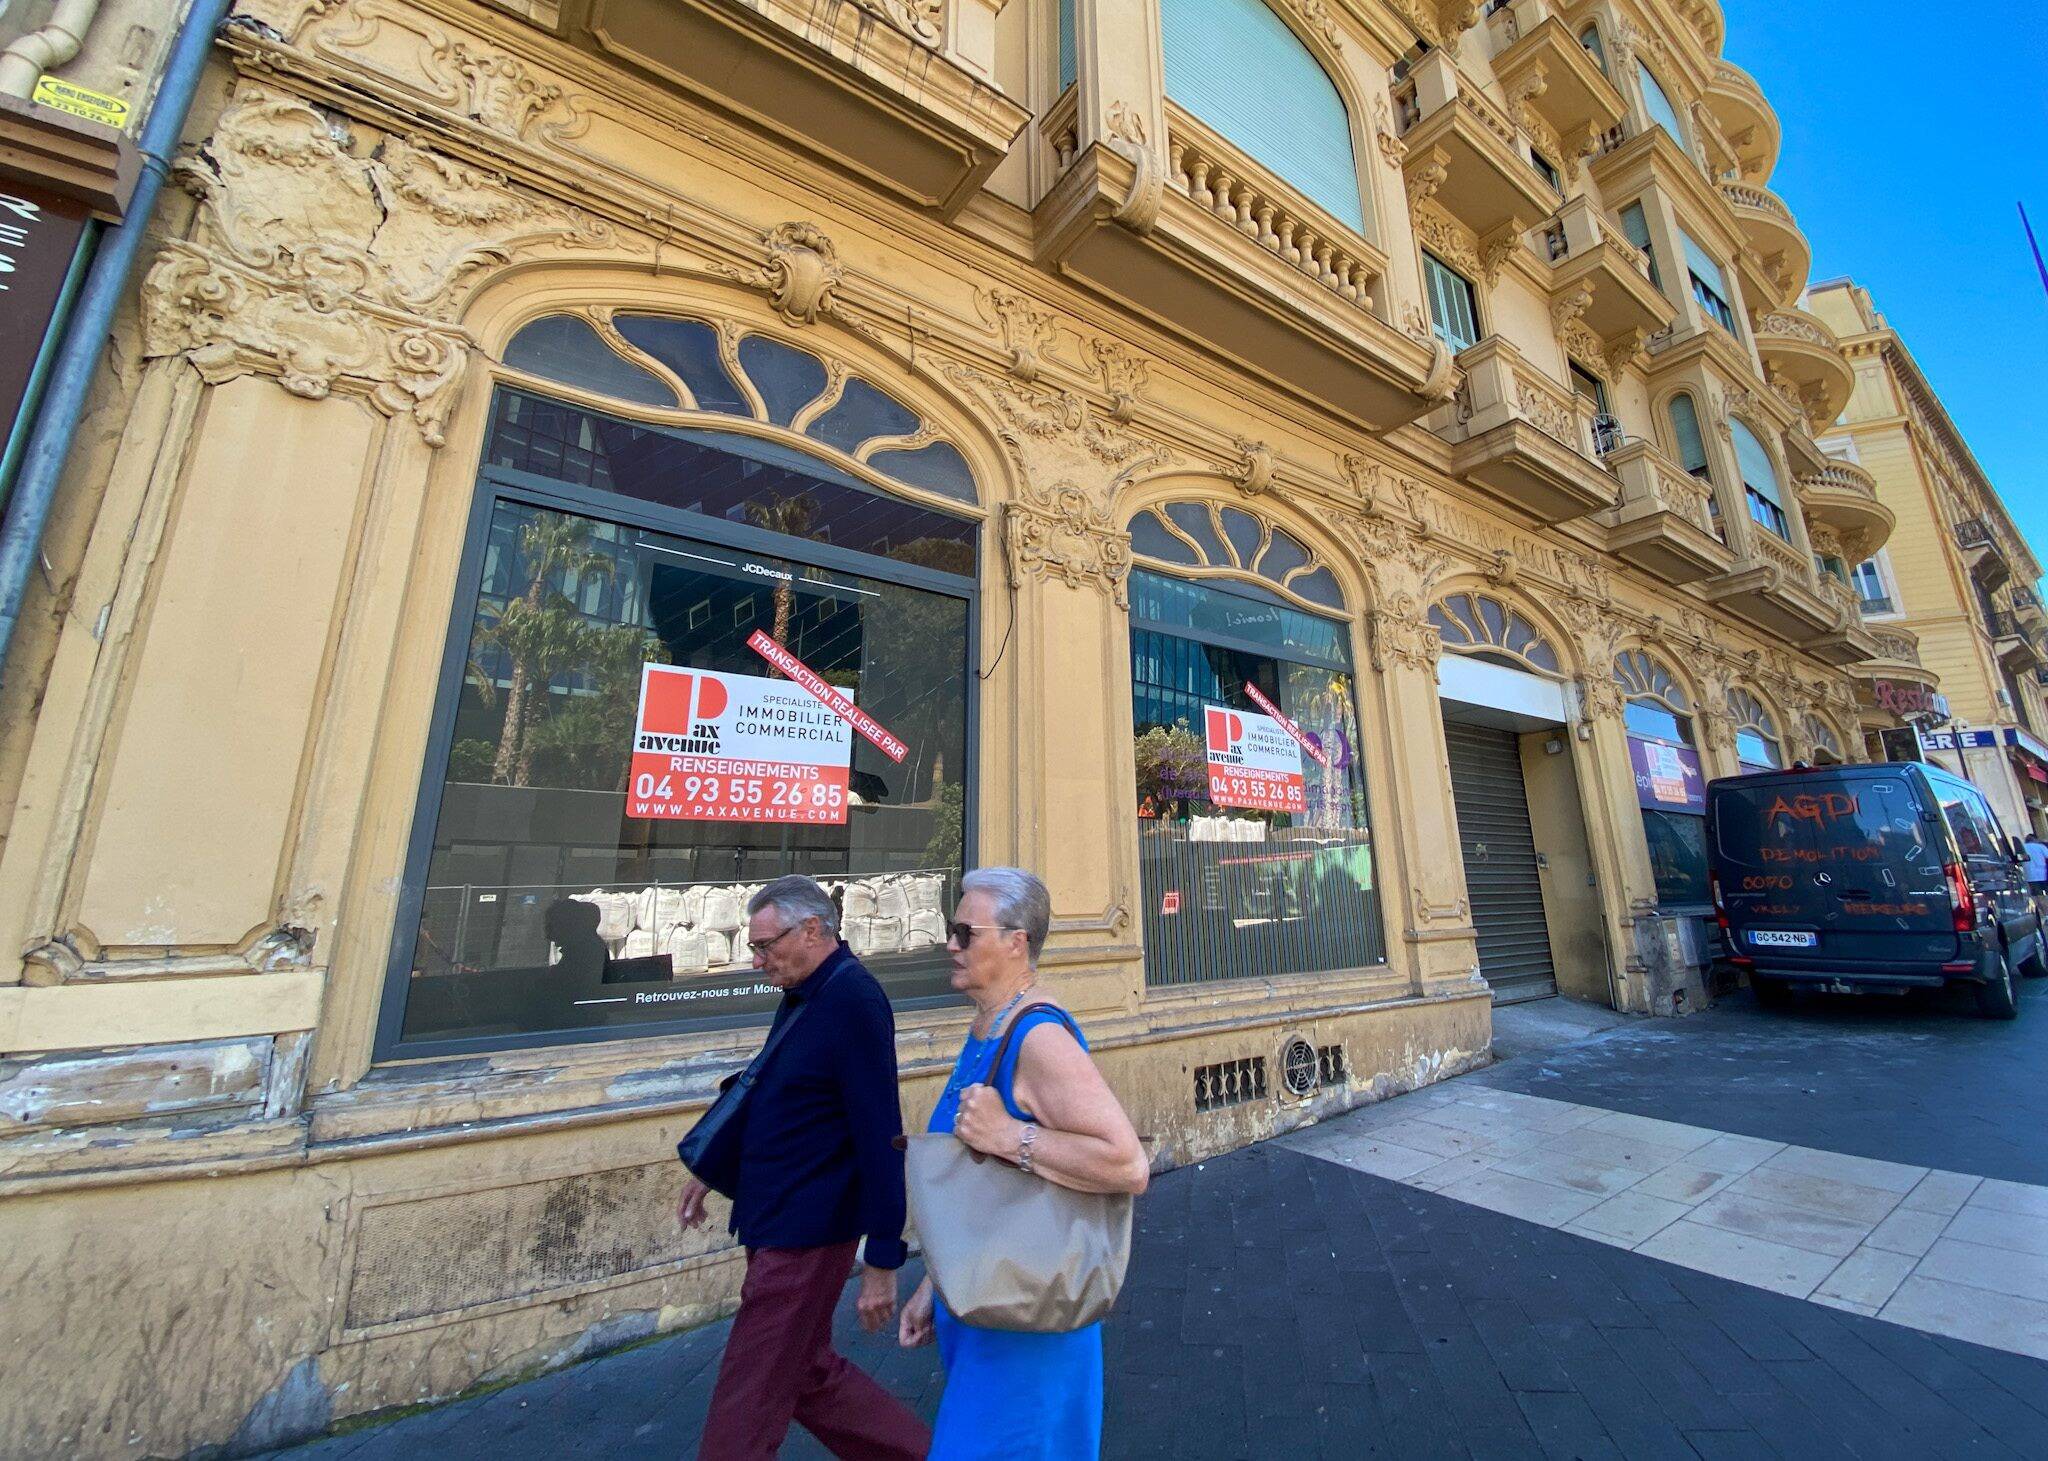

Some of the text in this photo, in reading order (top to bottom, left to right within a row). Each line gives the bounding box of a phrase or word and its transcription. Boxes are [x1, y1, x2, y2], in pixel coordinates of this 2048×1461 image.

[742, 563, 793, 581] JCDecaux
[753, 633, 905, 759] TRANSACTION REALISEE PAR
[763, 695, 823, 709] SPECIALISTE
[739, 705, 842, 727] IMMOBILIER
[1246, 684, 1288, 727] TRANSACTION
[1314, 750, 1327, 765] PAR
[736, 722, 843, 742] COMMERCIAL
[1248, 732, 1296, 747] IMMOBILIER
[639, 736, 721, 755] avenue
[1247, 743, 1297, 759] COMMERCIAL
[1209, 752, 1244, 765] avenue
[670, 759, 819, 780] RENSEIGNEMENTS
[1223, 767, 1289, 782] RENSEIGNEMENTS
[636, 773, 842, 807] 04 93 55 26 85
[1211, 776, 1228, 793] 04
[1231, 779, 1247, 796] 93
[1250, 781, 1266, 798] 55
[1269, 783, 1284, 799] 26
[1287, 785, 1301, 801] 85
[636, 804, 840, 821] WWW.PAXAVENUE.COM
[1756, 932, 1807, 944] GC-542-NB
[635, 988, 730, 1005] Retrouvez-nous
[733, 986, 750, 997] sur
